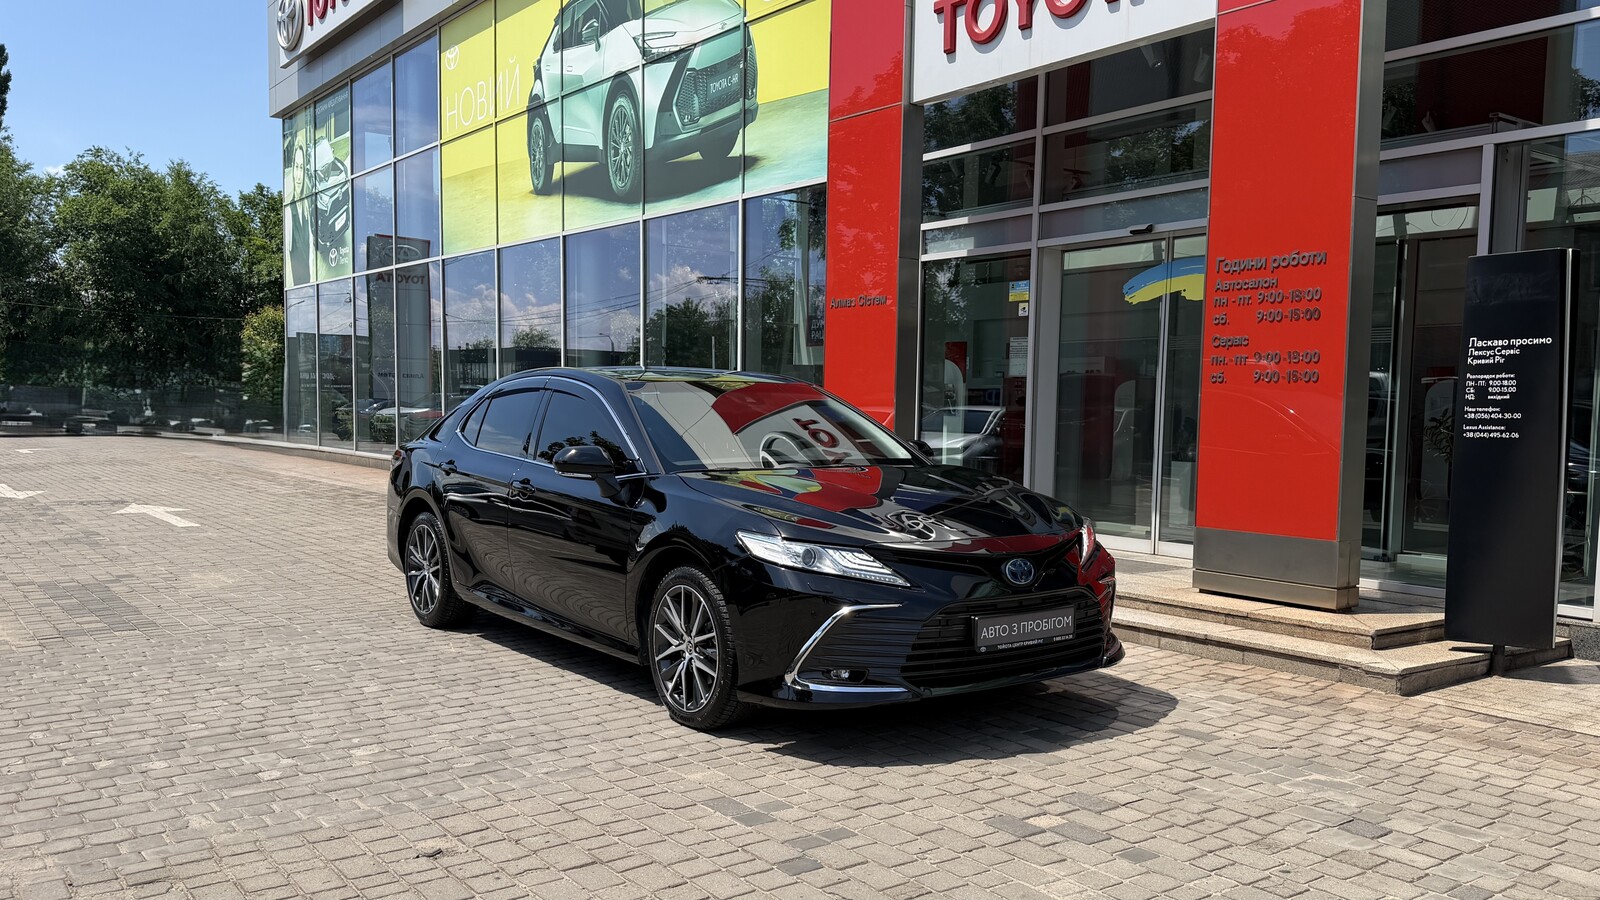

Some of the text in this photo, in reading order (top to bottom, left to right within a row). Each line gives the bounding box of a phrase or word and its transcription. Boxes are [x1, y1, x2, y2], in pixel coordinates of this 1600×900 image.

[710, 78, 727, 93] TOYOTA
[446, 56, 520, 133] НОВИЙ
[1216, 250, 1327, 274] Години роботи
[1215, 277, 1278, 292] Автосалон
[830, 295, 887, 309] Алмаз Сістем
[1213, 313, 1230, 325] сб.
[1212, 335, 1249, 350] Сервіс
[1469, 337, 1552, 347] Ласкаво просимо
[1468, 347, 1520, 357] Лексус Сервіс
[1467, 356, 1505, 365] Кривий Ріг
[1210, 371, 1227, 384] сб.
[1475, 412, 1491, 420] (056)
[980, 615, 1072, 640] АВТО З ПРОБІГОМ
